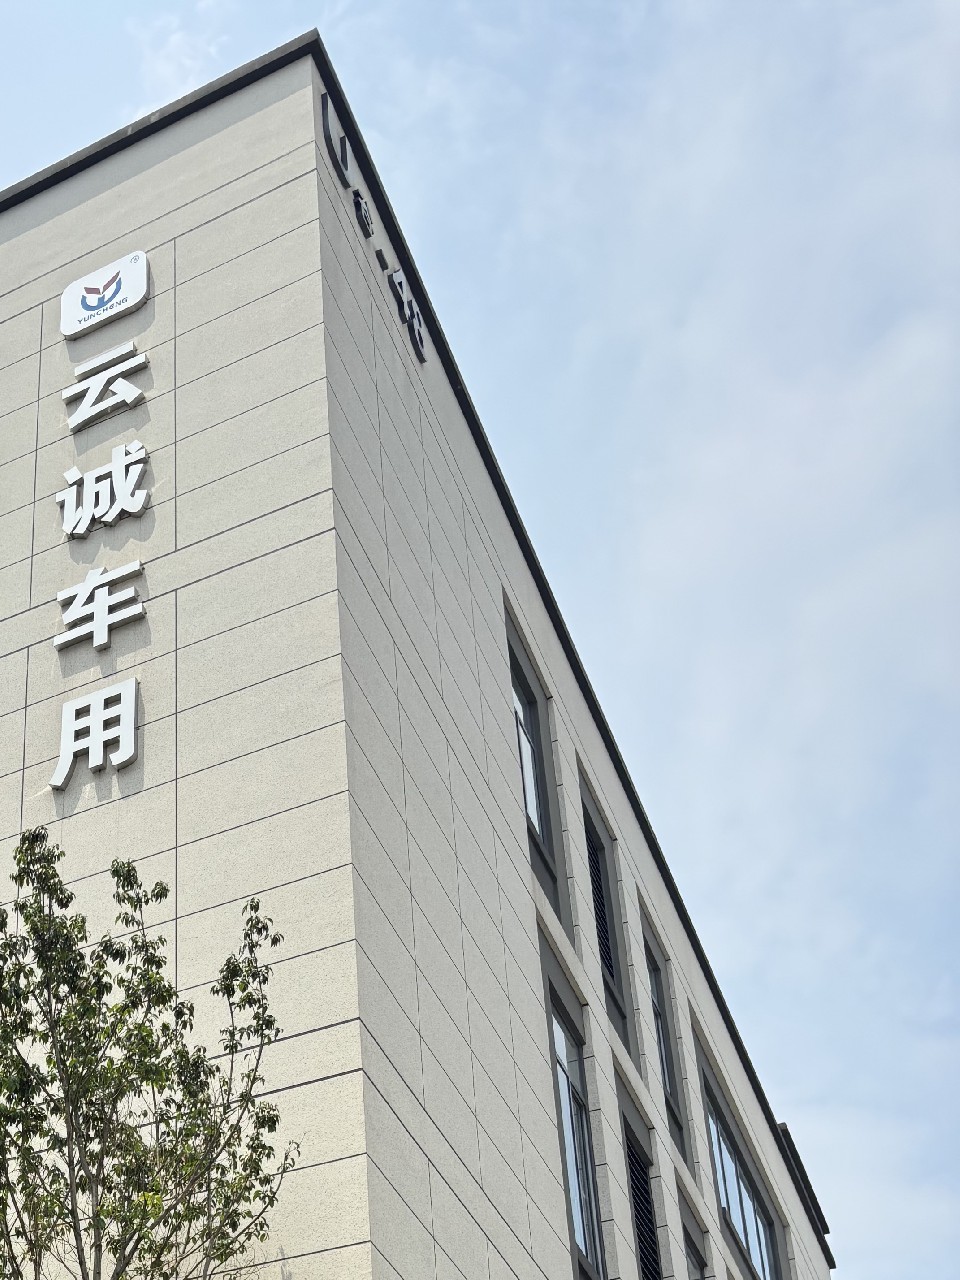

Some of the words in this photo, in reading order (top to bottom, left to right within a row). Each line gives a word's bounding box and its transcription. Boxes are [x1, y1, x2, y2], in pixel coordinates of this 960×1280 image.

[77, 296, 129, 325] YUNCHENG
[49, 341, 148, 790] 云诚车用
